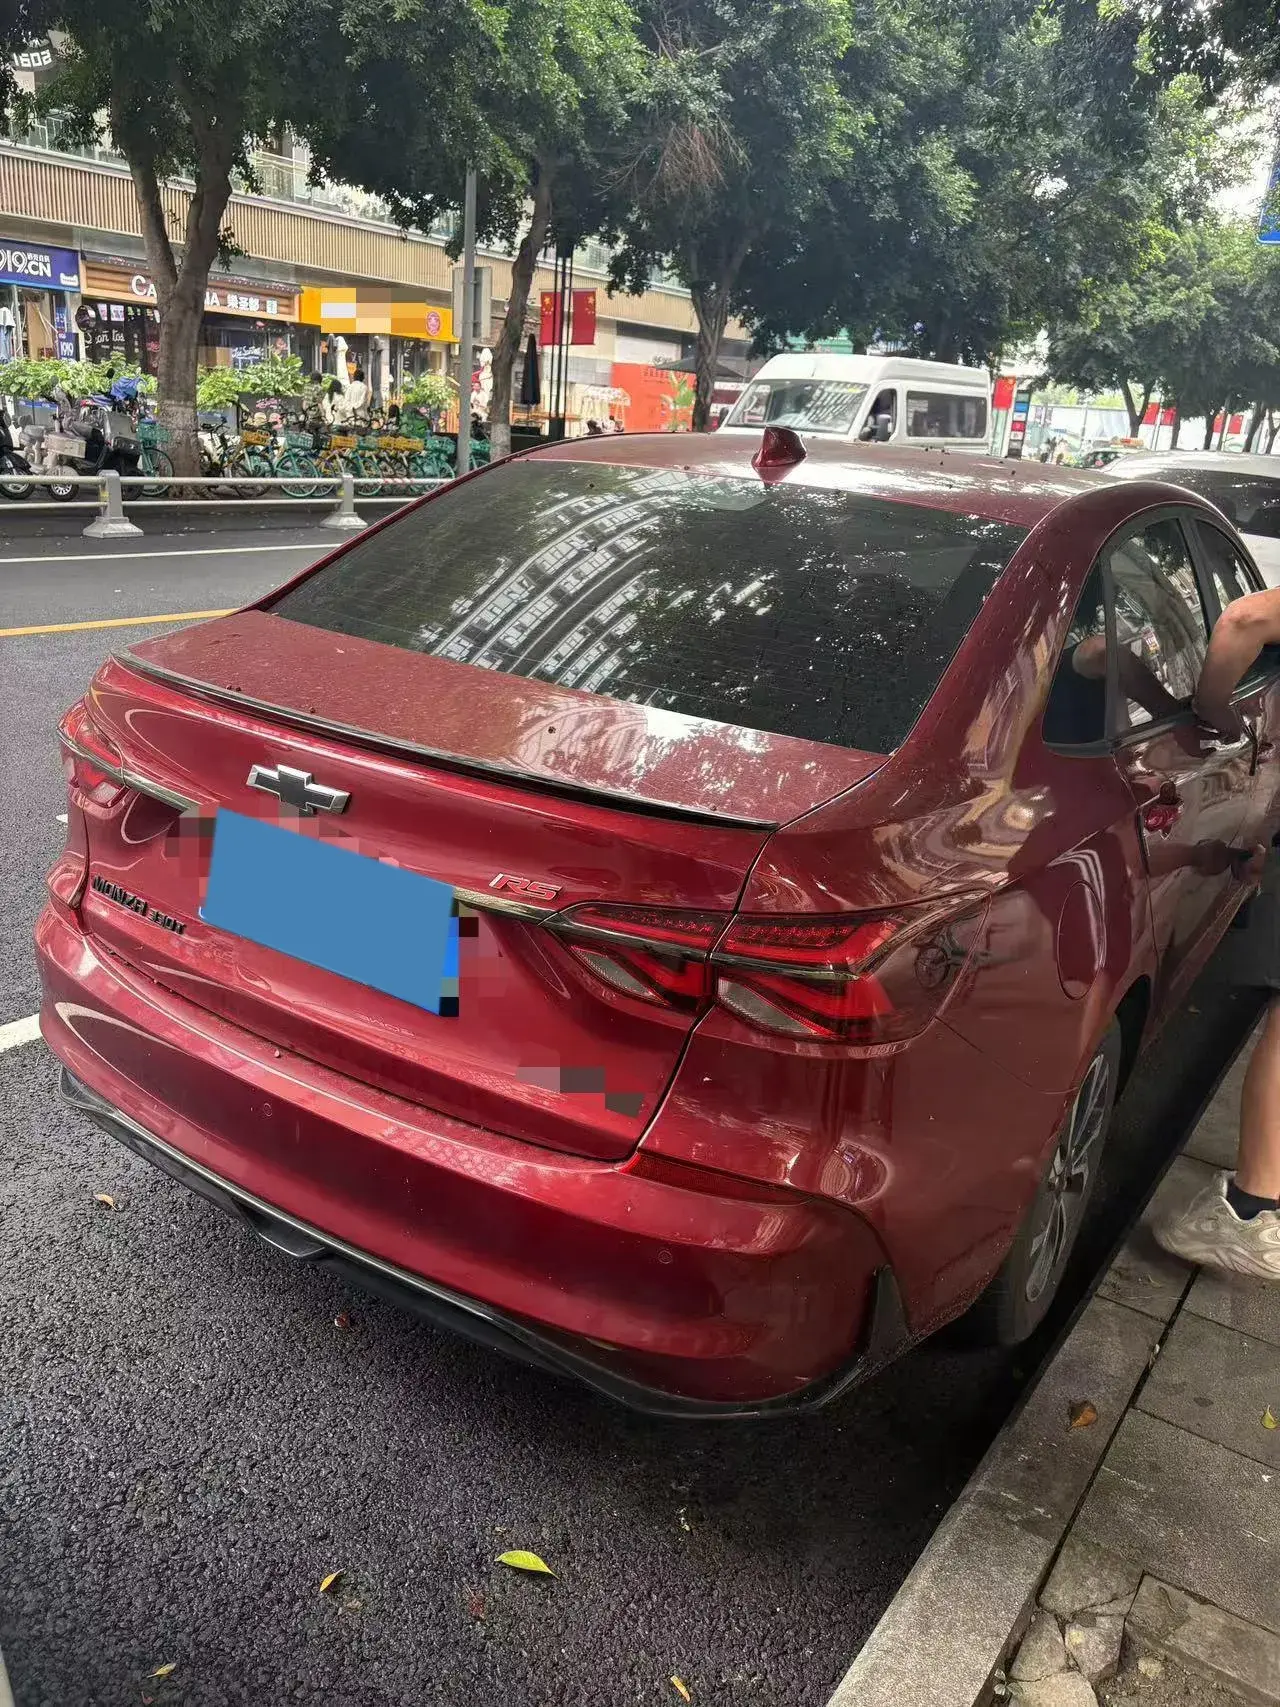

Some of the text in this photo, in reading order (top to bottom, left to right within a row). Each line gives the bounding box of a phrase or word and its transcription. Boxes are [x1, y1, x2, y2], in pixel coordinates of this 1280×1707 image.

[13, 49, 52, 68] 1602
[488, 873, 563, 900] RS
[92, 875, 187, 935] MONZA 330T
